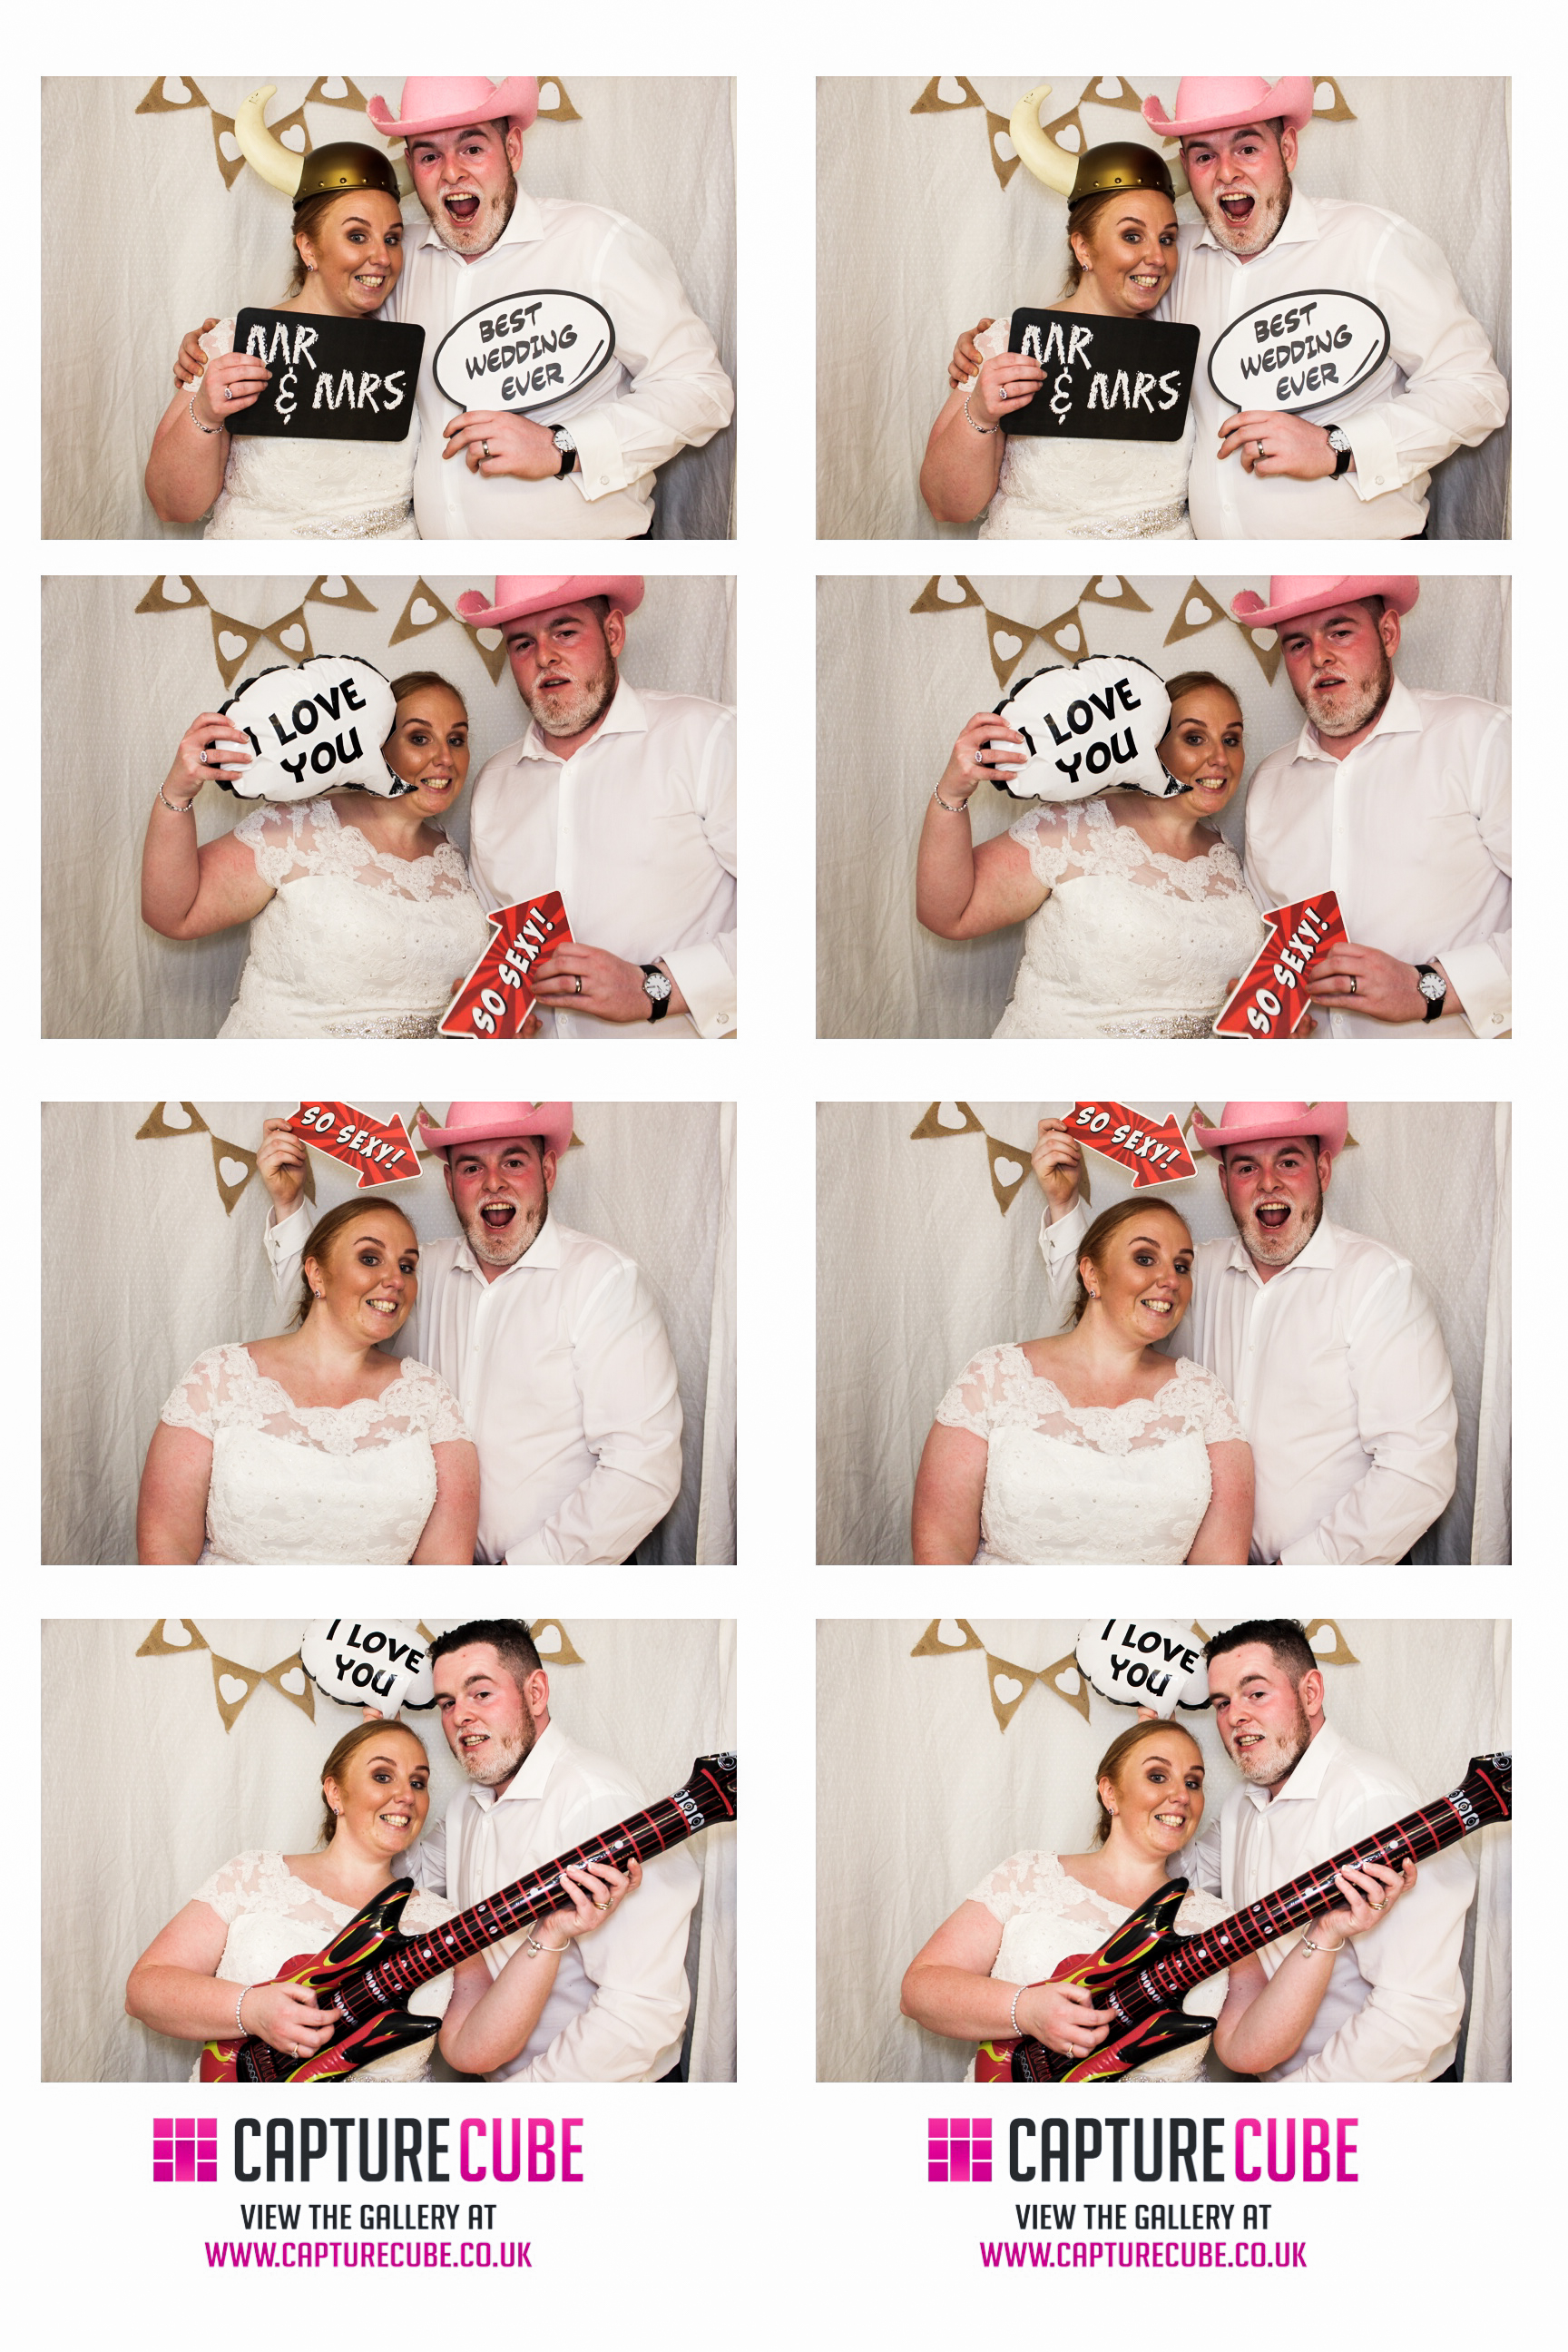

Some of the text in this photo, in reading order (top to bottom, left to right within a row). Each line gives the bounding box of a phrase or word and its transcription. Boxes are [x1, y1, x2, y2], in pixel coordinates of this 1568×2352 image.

[246, 321, 318, 369] MR
[479, 301, 543, 344] BEST
[1021, 321, 1093, 369] MR
[1254, 301, 1318, 344] BEST
[465, 323, 578, 380] WEDDING
[1240, 323, 1353, 380] WEDDING
[274, 367, 407, 426] & MRS
[501, 362, 564, 402] EVER
[1049, 367, 1181, 426] & MRS
[1276, 362, 1339, 402] EVER
[268, 677, 367, 746] LOVE
[1043, 677, 1142, 746] LOVE
[279, 726, 364, 783] YOU
[1054, 726, 1139, 783] YOU
[471, 906, 556, 1035] SO SEXY!
[1246, 906, 1331, 1035] SO SEXY!
[300, 1106, 407, 1170] SO SEXY!
[1075, 1106, 1181, 1170] SO SEXY!
[326, 1618, 426, 1674] I LOVE
[1101, 1618, 1200, 1674] I LOVE
[335, 1653, 398, 1697] YOU
[1110, 1653, 1173, 1697] YOU
